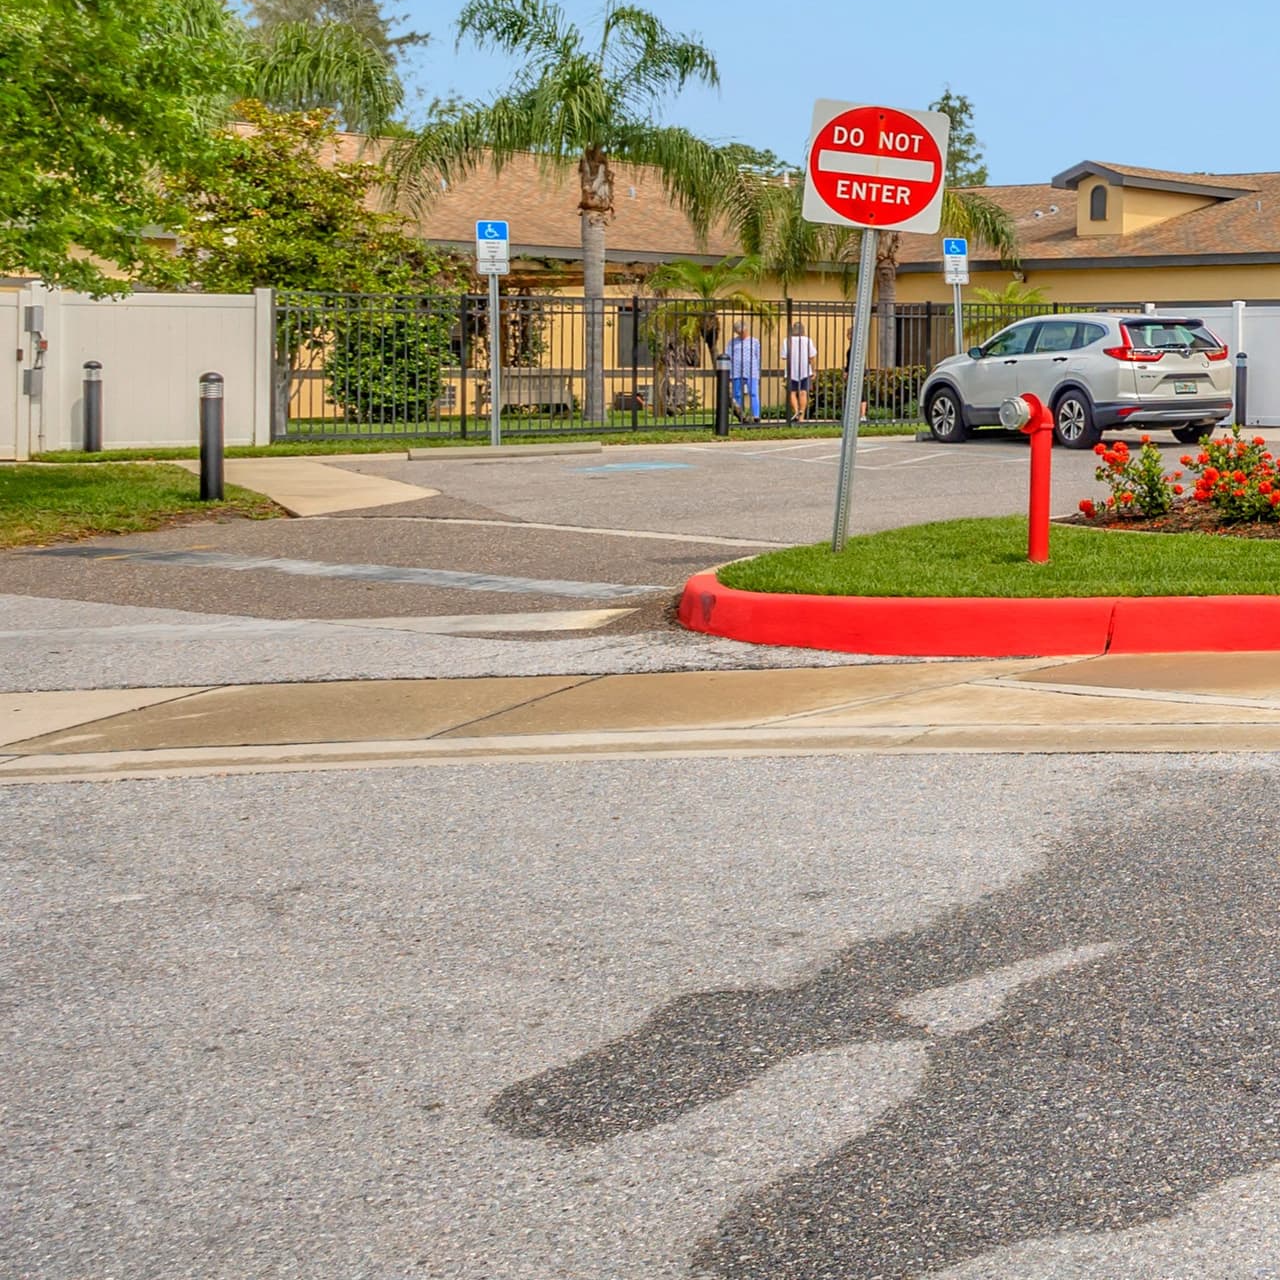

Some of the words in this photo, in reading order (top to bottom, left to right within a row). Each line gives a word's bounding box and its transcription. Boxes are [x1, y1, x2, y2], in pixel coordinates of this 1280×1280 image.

[833, 126, 865, 147] DO
[878, 131, 923, 153] NOT
[836, 179, 911, 205] ENTER
